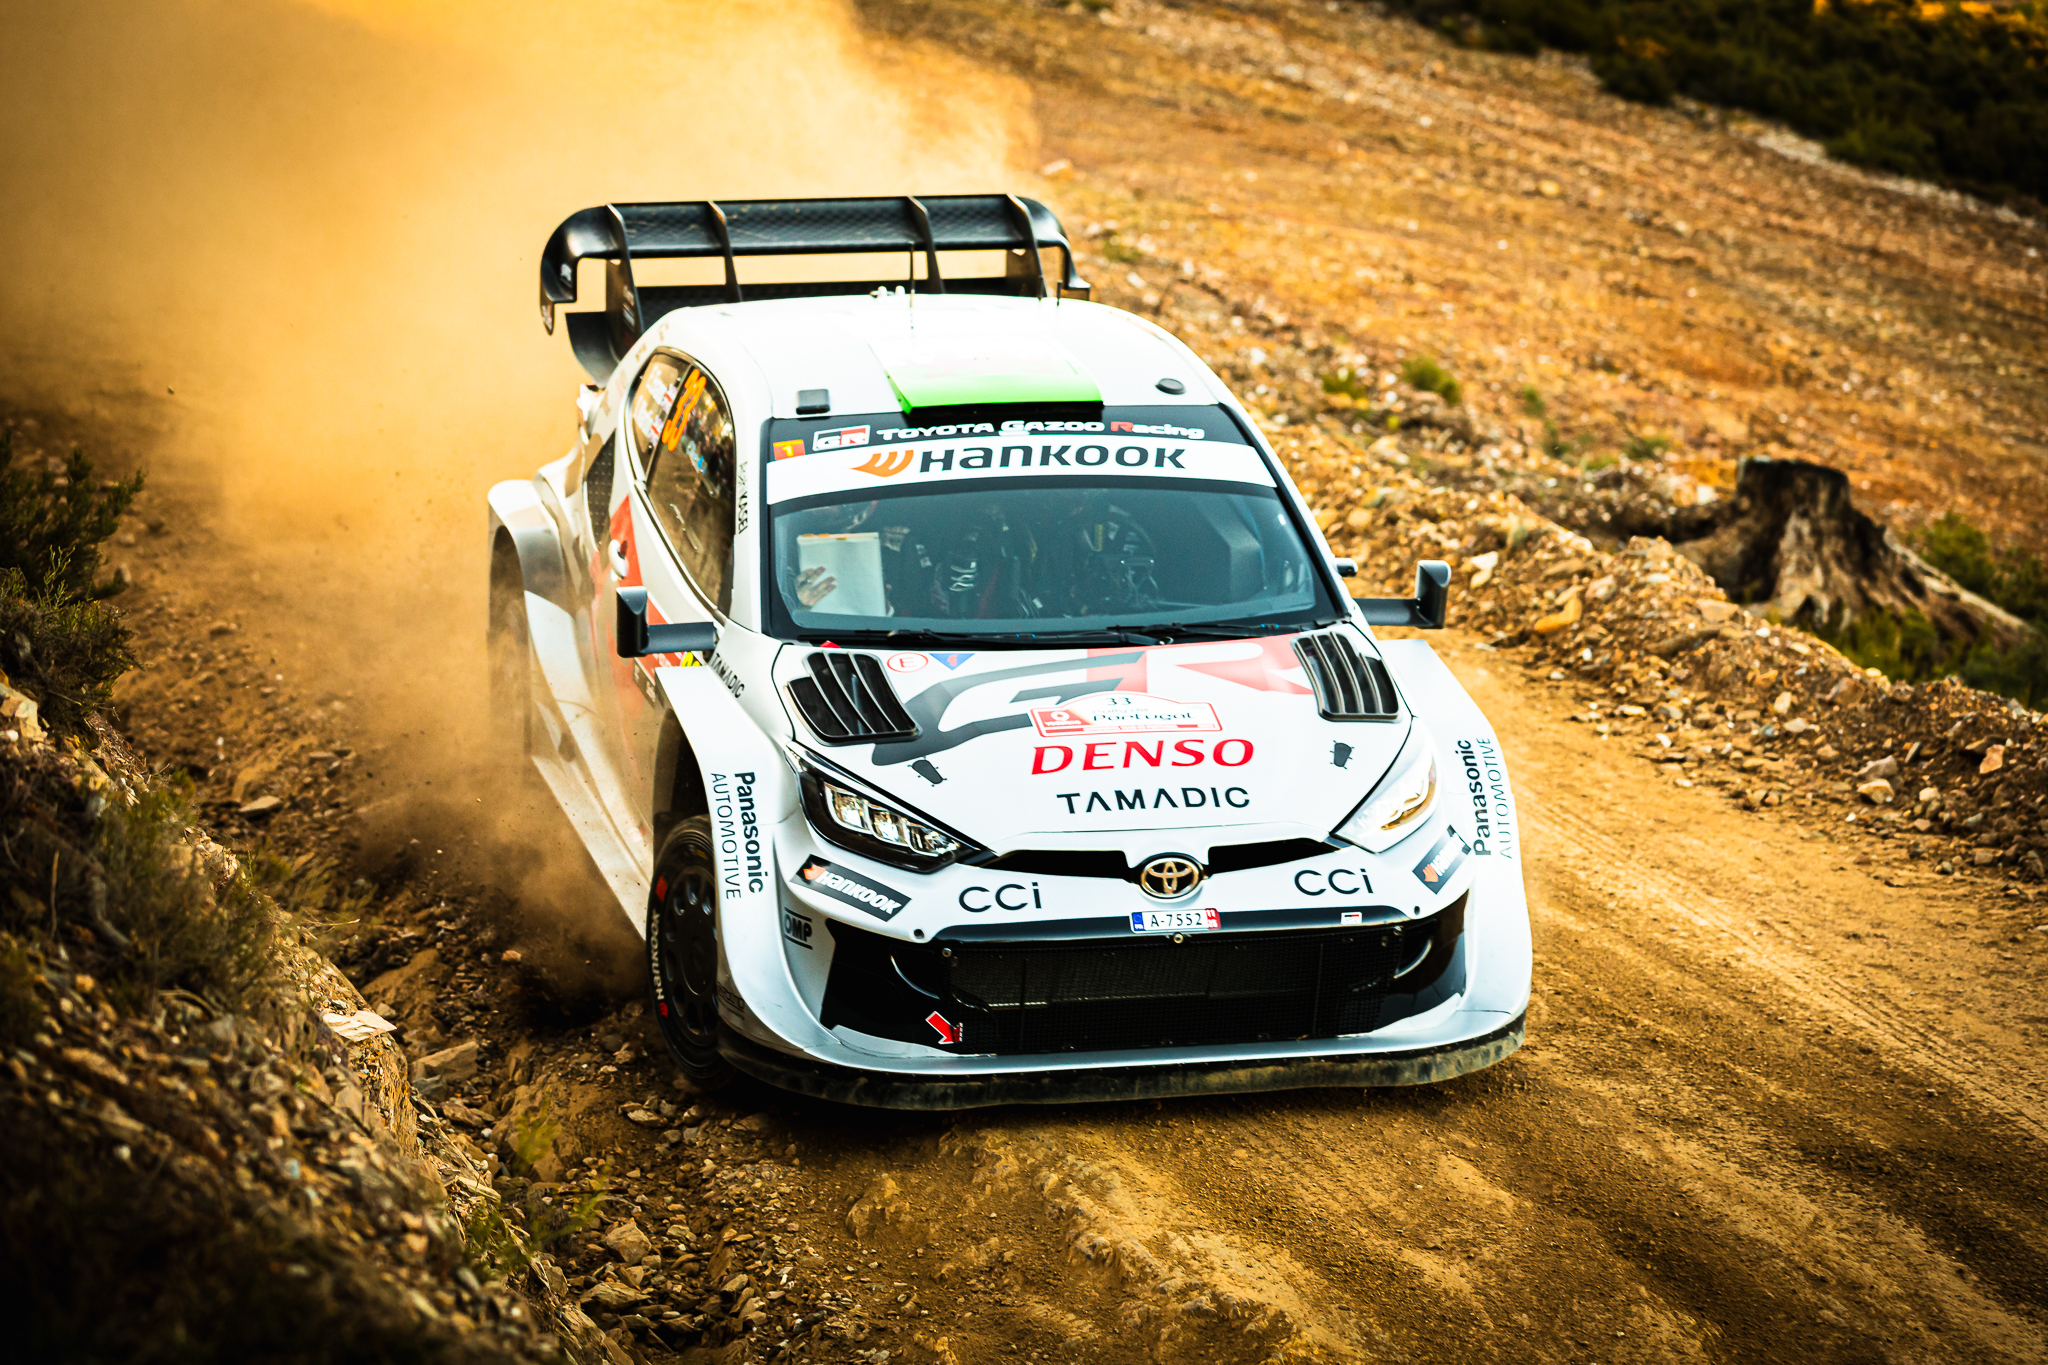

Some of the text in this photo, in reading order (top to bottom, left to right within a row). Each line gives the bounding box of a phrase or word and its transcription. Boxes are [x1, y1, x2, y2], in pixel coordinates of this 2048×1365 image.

[877, 422, 994, 441] TOYOTA
[1001, 420, 1105, 436] GAZOO
[1110, 421, 1205, 440] Racing
[711, 653, 745, 699] TAMADIC
[1093, 712, 1195, 722] Portugal
[1106, 697, 1132, 706] 33
[1031, 738, 1255, 775] DENSO
[1056, 786, 1251, 815] TAMADIC
[1455, 739, 1492, 856] Panasonic
[1475, 737, 1513, 860] AUTOMOTIVE
[710, 772, 742, 900] AUTOMOTIVE
[734, 771, 769, 894] Panasonic
[785, 911, 812, 943] OMP
[1150, 911, 1203, 929] A-7552
